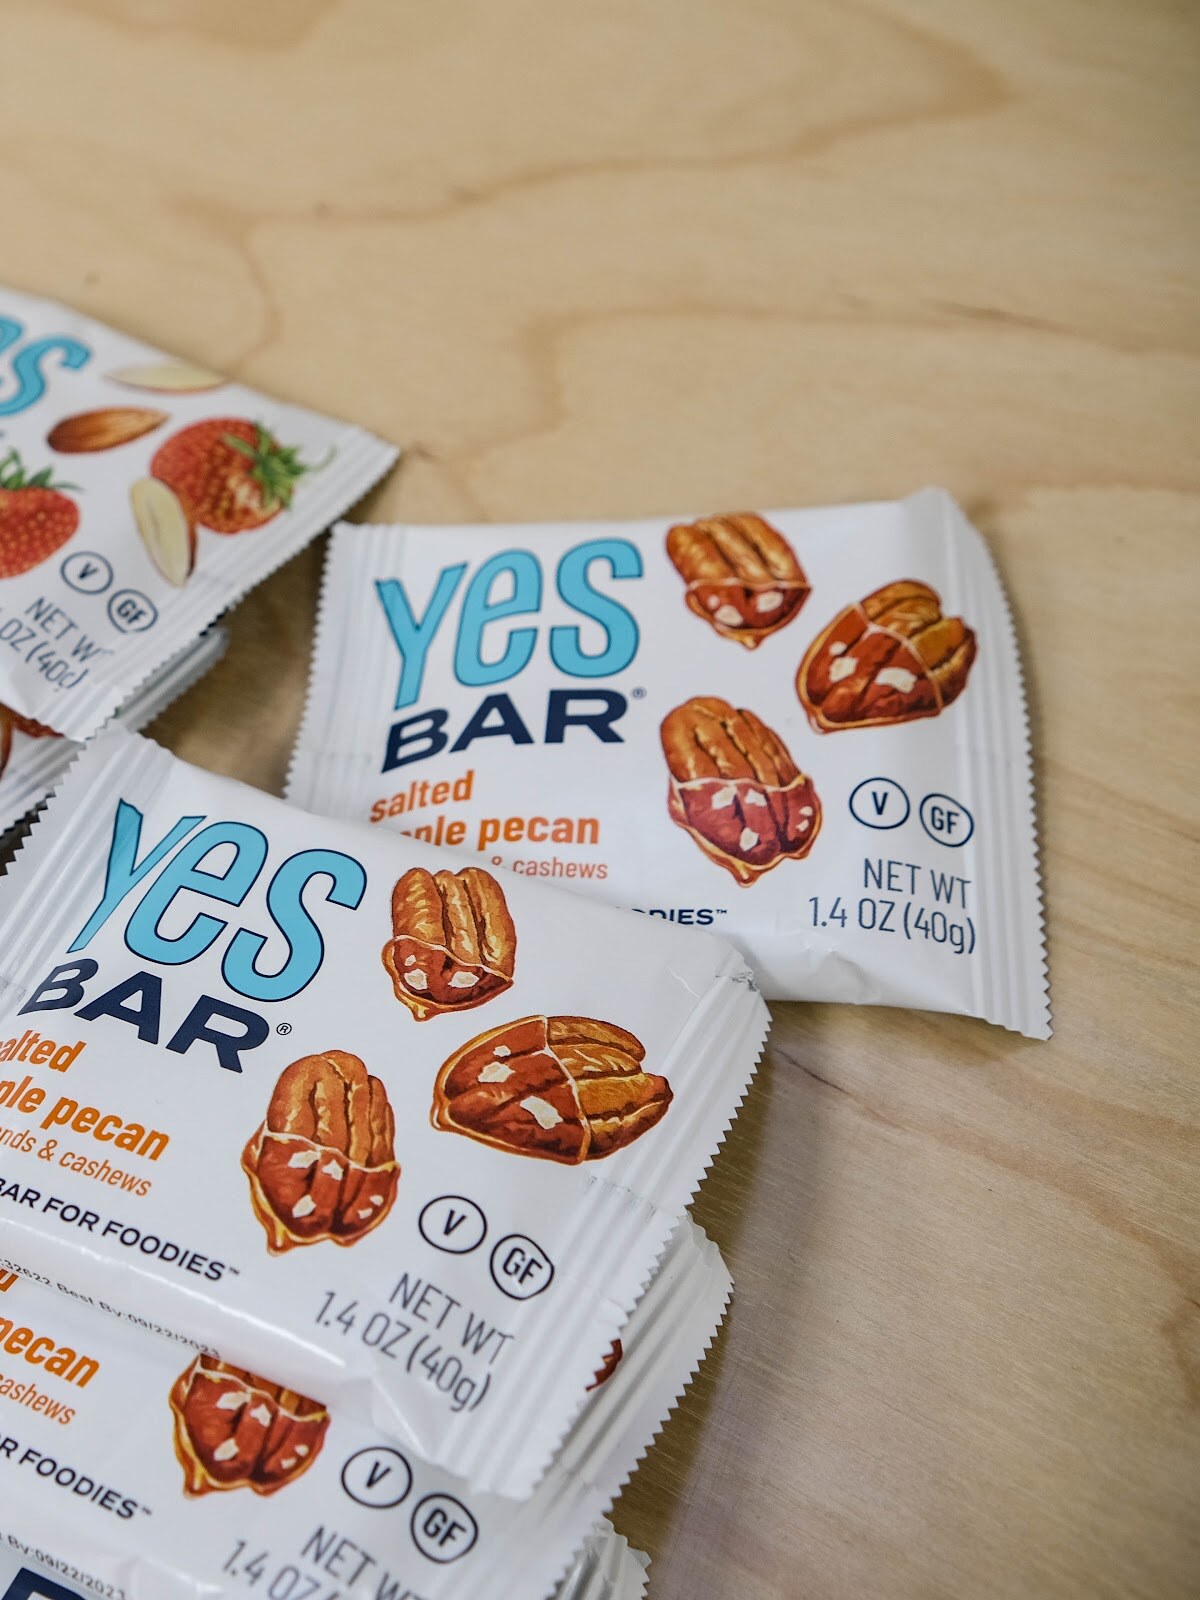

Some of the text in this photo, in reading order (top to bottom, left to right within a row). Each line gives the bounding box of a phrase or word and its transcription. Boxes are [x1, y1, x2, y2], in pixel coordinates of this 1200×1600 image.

[24, 596, 79, 641] NET
[374, 537, 643, 711] yes
[368, 769, 475, 824] salted
[930, 806, 960, 835] GF
[477, 816, 601, 851] pecan
[512, 857, 608, 880] cashews
[864, 857, 972, 909] NET WT
[66, 798, 368, 1003] yes
[809, 896, 976, 955] 1.4 OZ (40g)
[40, 1095, 170, 1162] pecan
[37, 1138, 59, 1162] &
[58, 1150, 153, 1198] cashews
[41, 1197, 101, 1234] FOR
[502, 1246, 543, 1286] GF
[389, 1271, 515, 1366] NET WT
[314, 1290, 492, 1412] 1.4 OZ (40g)
[422, 1507, 468, 1548] GF
[222, 1539, 269, 1587] 1.4
[301, 1523, 377, 1588] NET
